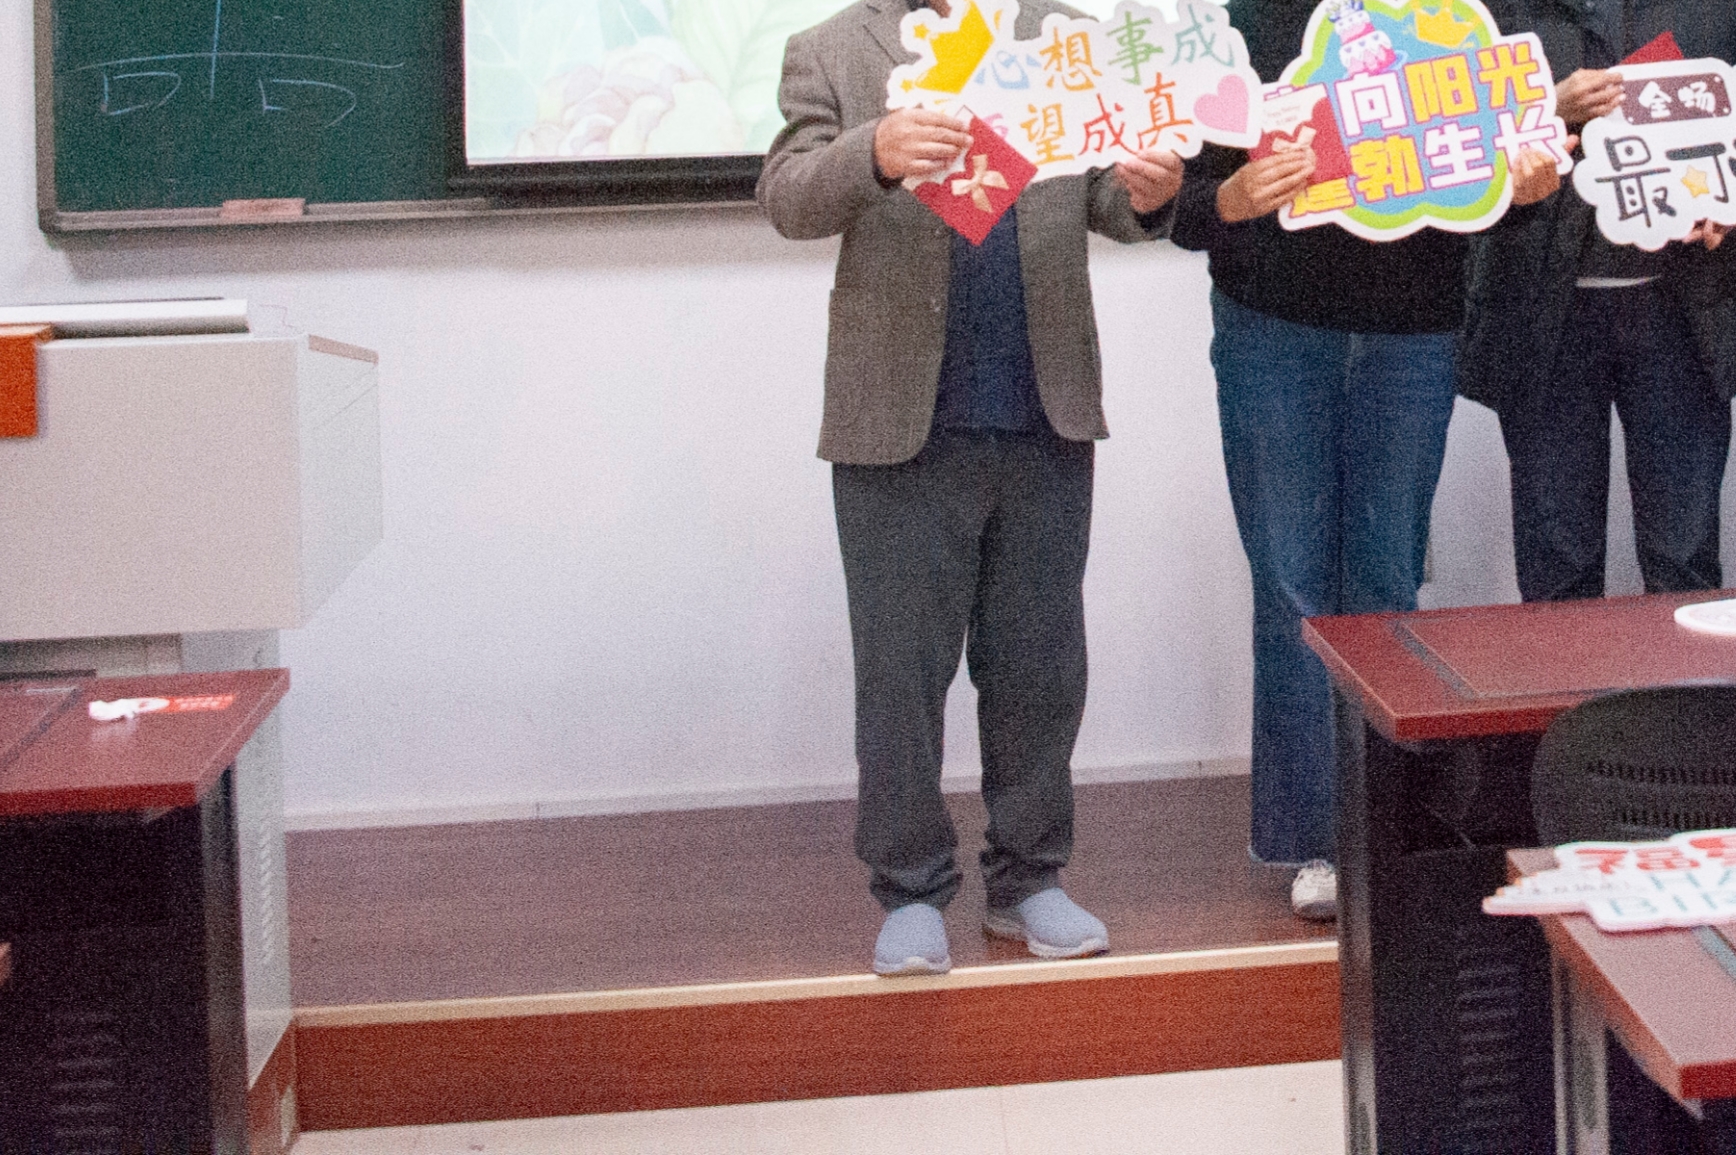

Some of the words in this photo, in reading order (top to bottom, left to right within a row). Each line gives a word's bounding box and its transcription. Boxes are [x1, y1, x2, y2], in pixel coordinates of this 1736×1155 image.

[973, 4, 1236, 92] 心想事成
[981, 72, 1195, 167] 望成真
